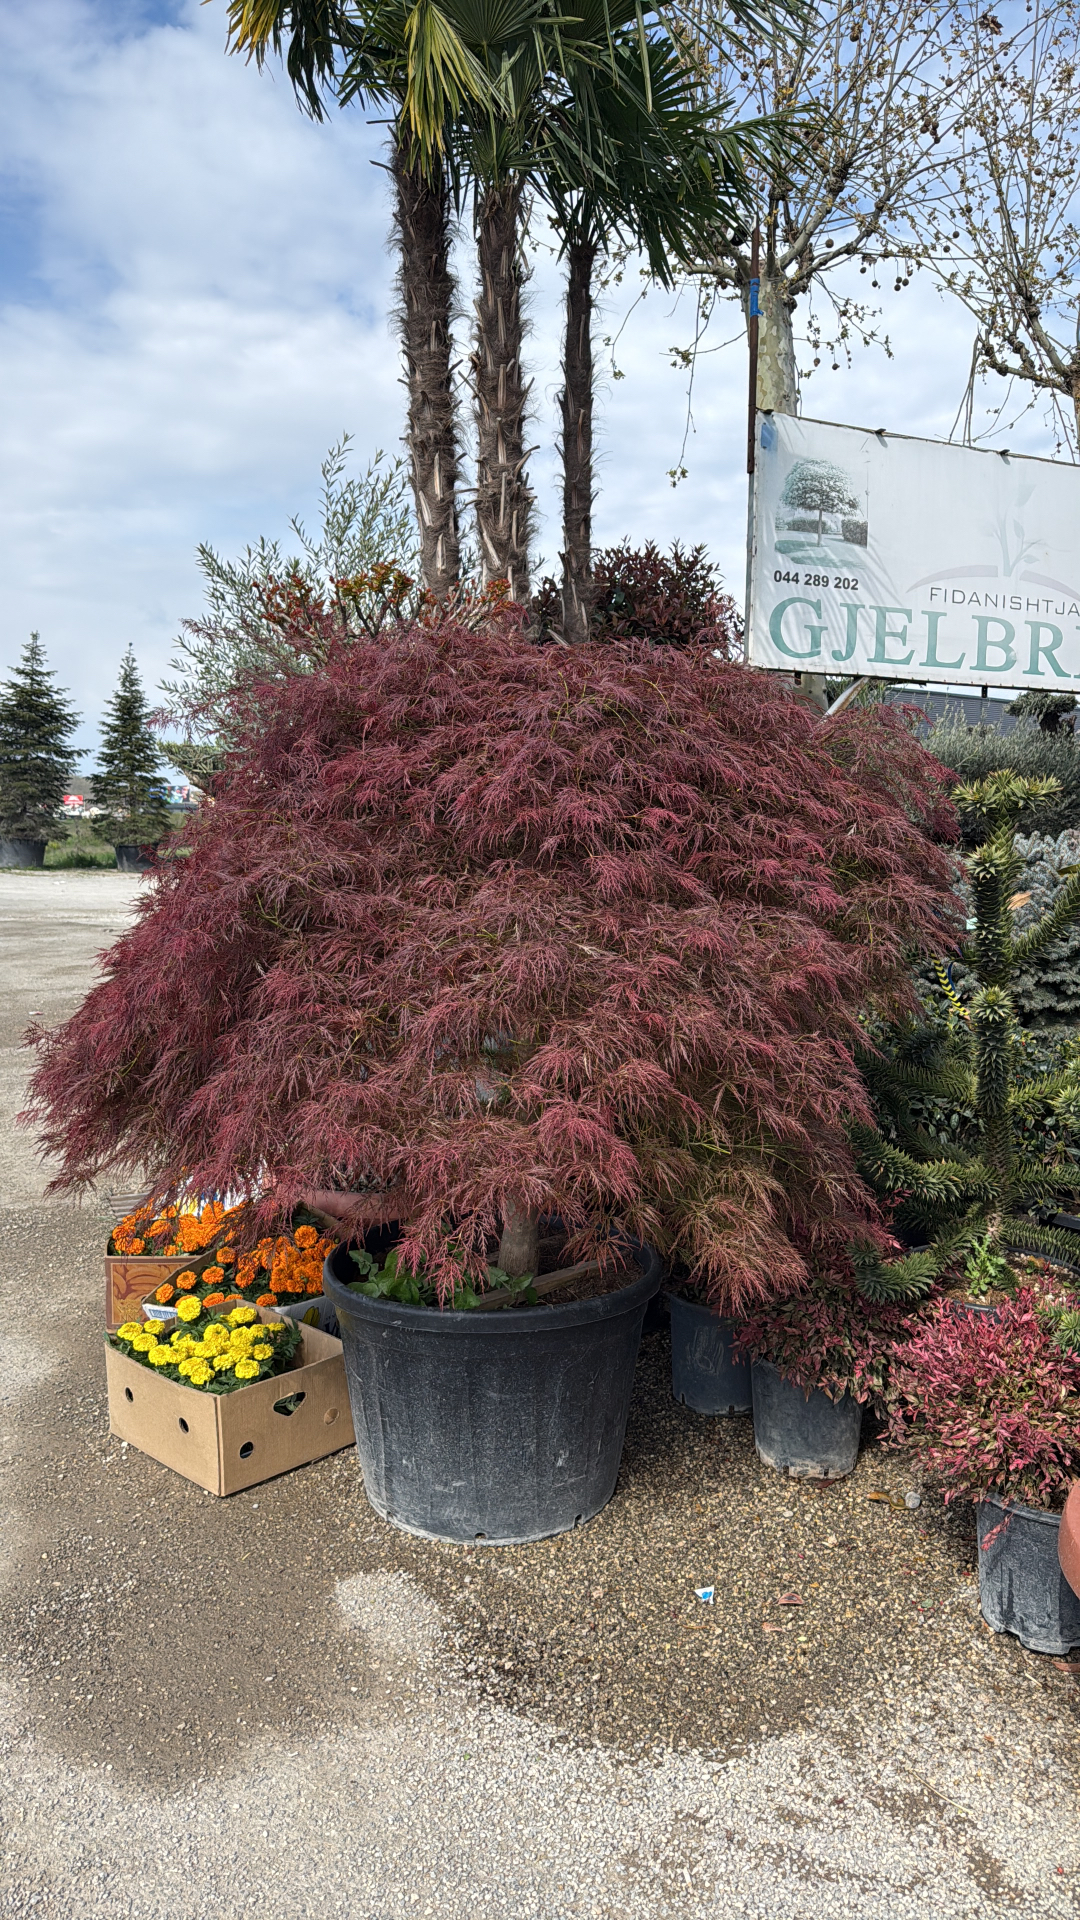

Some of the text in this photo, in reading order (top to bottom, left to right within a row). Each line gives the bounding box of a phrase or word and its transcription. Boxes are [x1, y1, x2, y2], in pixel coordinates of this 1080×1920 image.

[773, 570, 860, 591] 044 289 202
[929, 587, 1080, 617] FIDANISHTJA
[768, 596, 1080, 679] GJELBR
